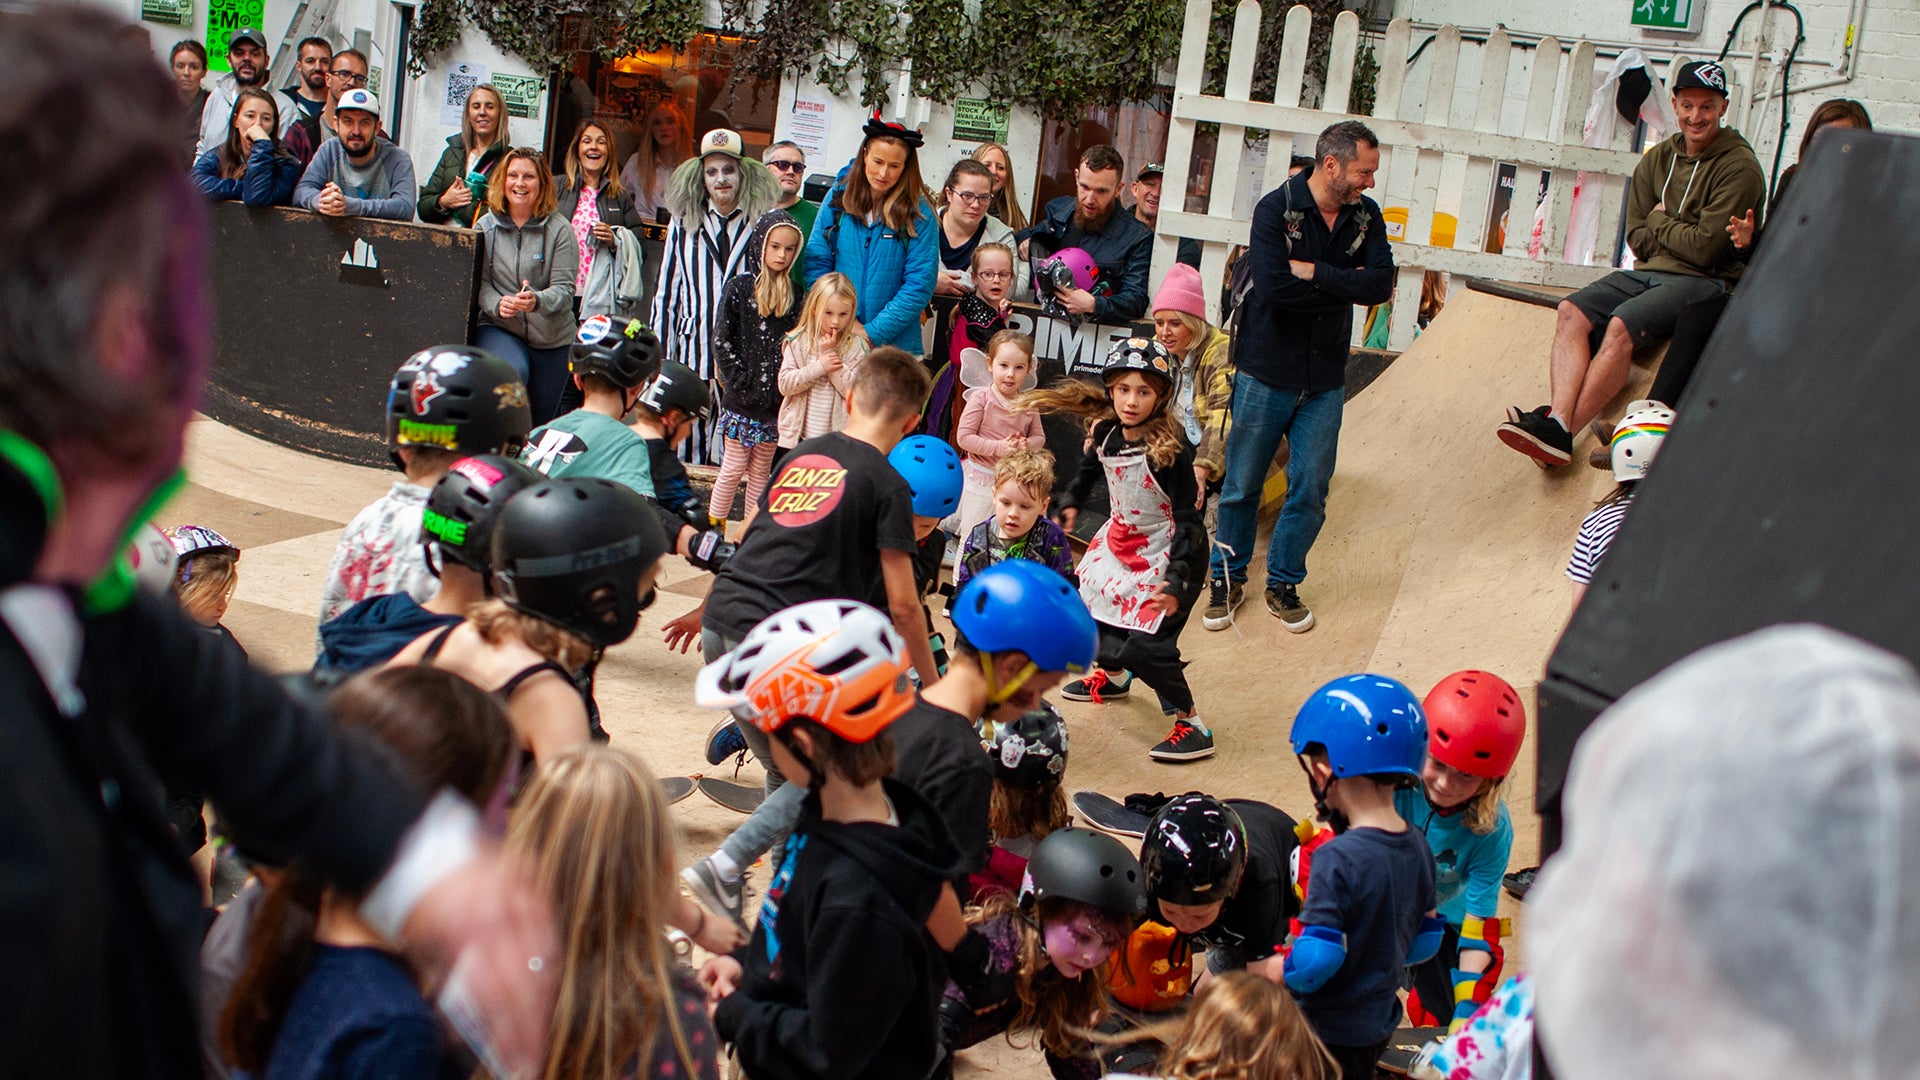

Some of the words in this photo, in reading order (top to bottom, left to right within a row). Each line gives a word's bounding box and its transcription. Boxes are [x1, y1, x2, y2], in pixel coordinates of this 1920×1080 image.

[957, 106, 979, 114] STOCK
[956, 113, 991, 121] AVAILABLE
[960, 148, 975, 156] WA
[772, 467, 849, 489] SANTA
[768, 491, 832, 513] CRUZ
